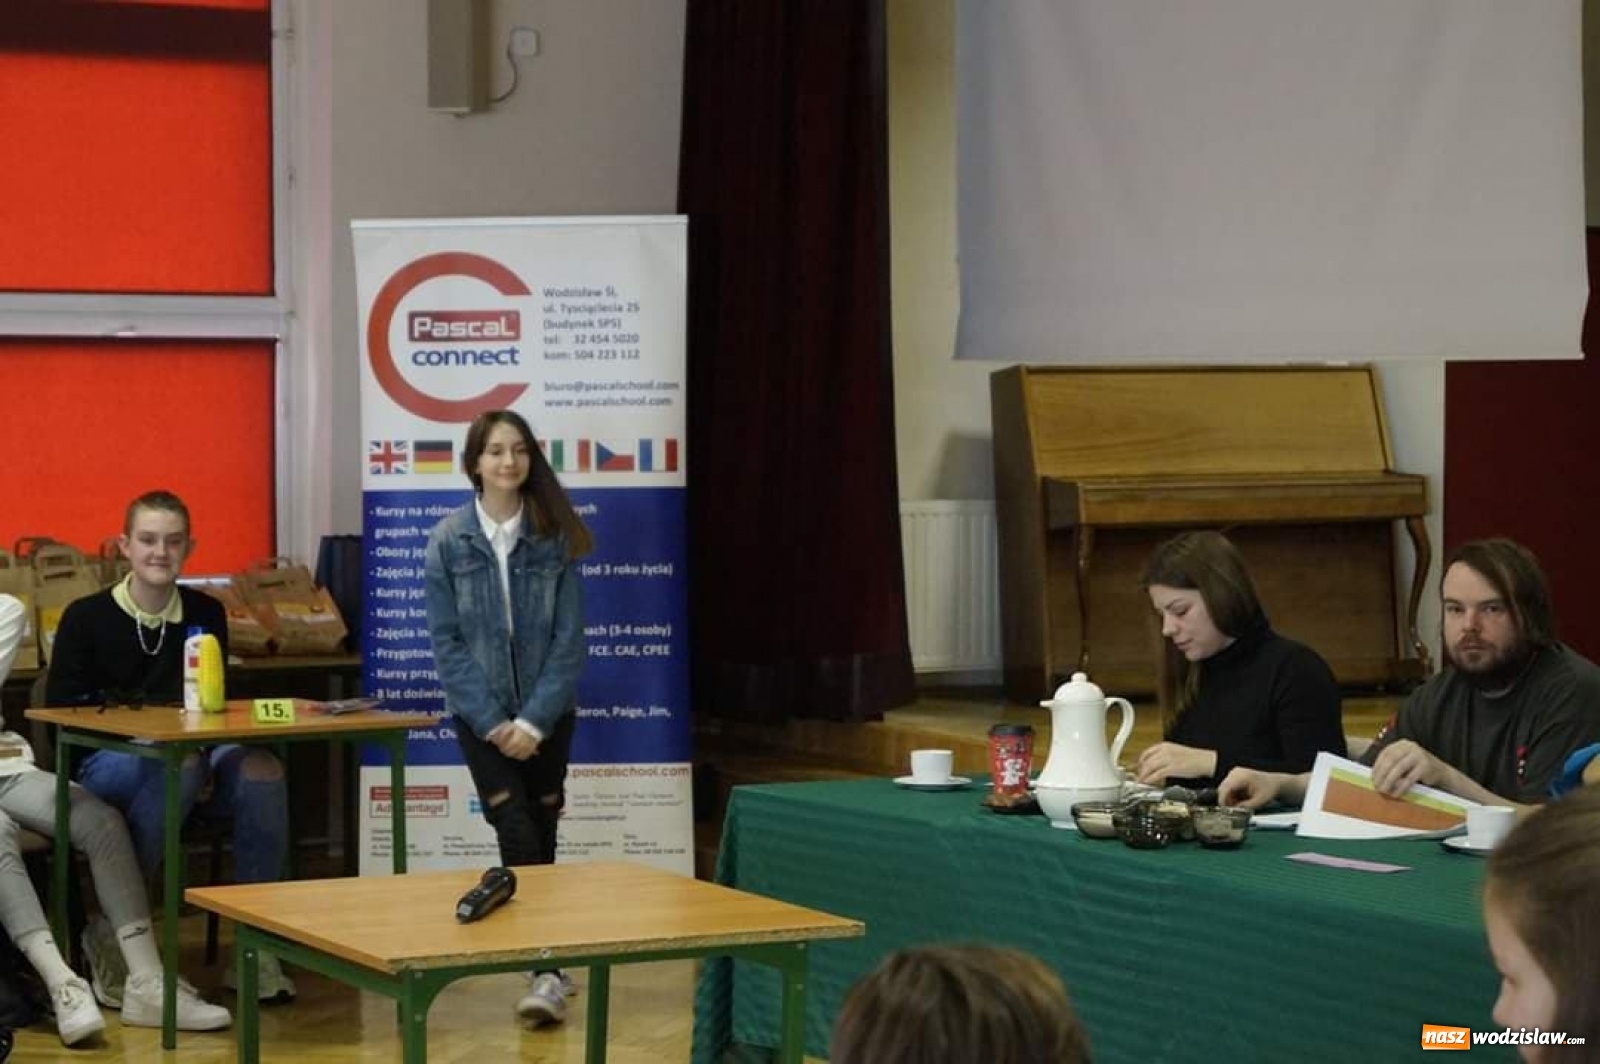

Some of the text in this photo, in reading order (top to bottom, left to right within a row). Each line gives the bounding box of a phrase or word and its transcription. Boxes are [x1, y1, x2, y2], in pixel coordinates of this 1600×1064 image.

[411, 346, 520, 366] connect
[375, 506, 406, 518] Kursy
[408, 507, 422, 517] na
[375, 526, 419, 539] grupach
[375, 566, 414, 579] Zajęcia
[582, 563, 601, 577] (od
[603, 564, 611, 575] 3
[613, 563, 640, 575] roku
[375, 587, 407, 599] Kursy
[376, 608, 408, 619] Kursy
[376, 627, 415, 640] Zajęcia
[634, 624, 672, 638] osoby)
[376, 669, 407, 680] Kursy
[387, 688, 401, 699] lat
[375, 803, 445, 816] Adantage
